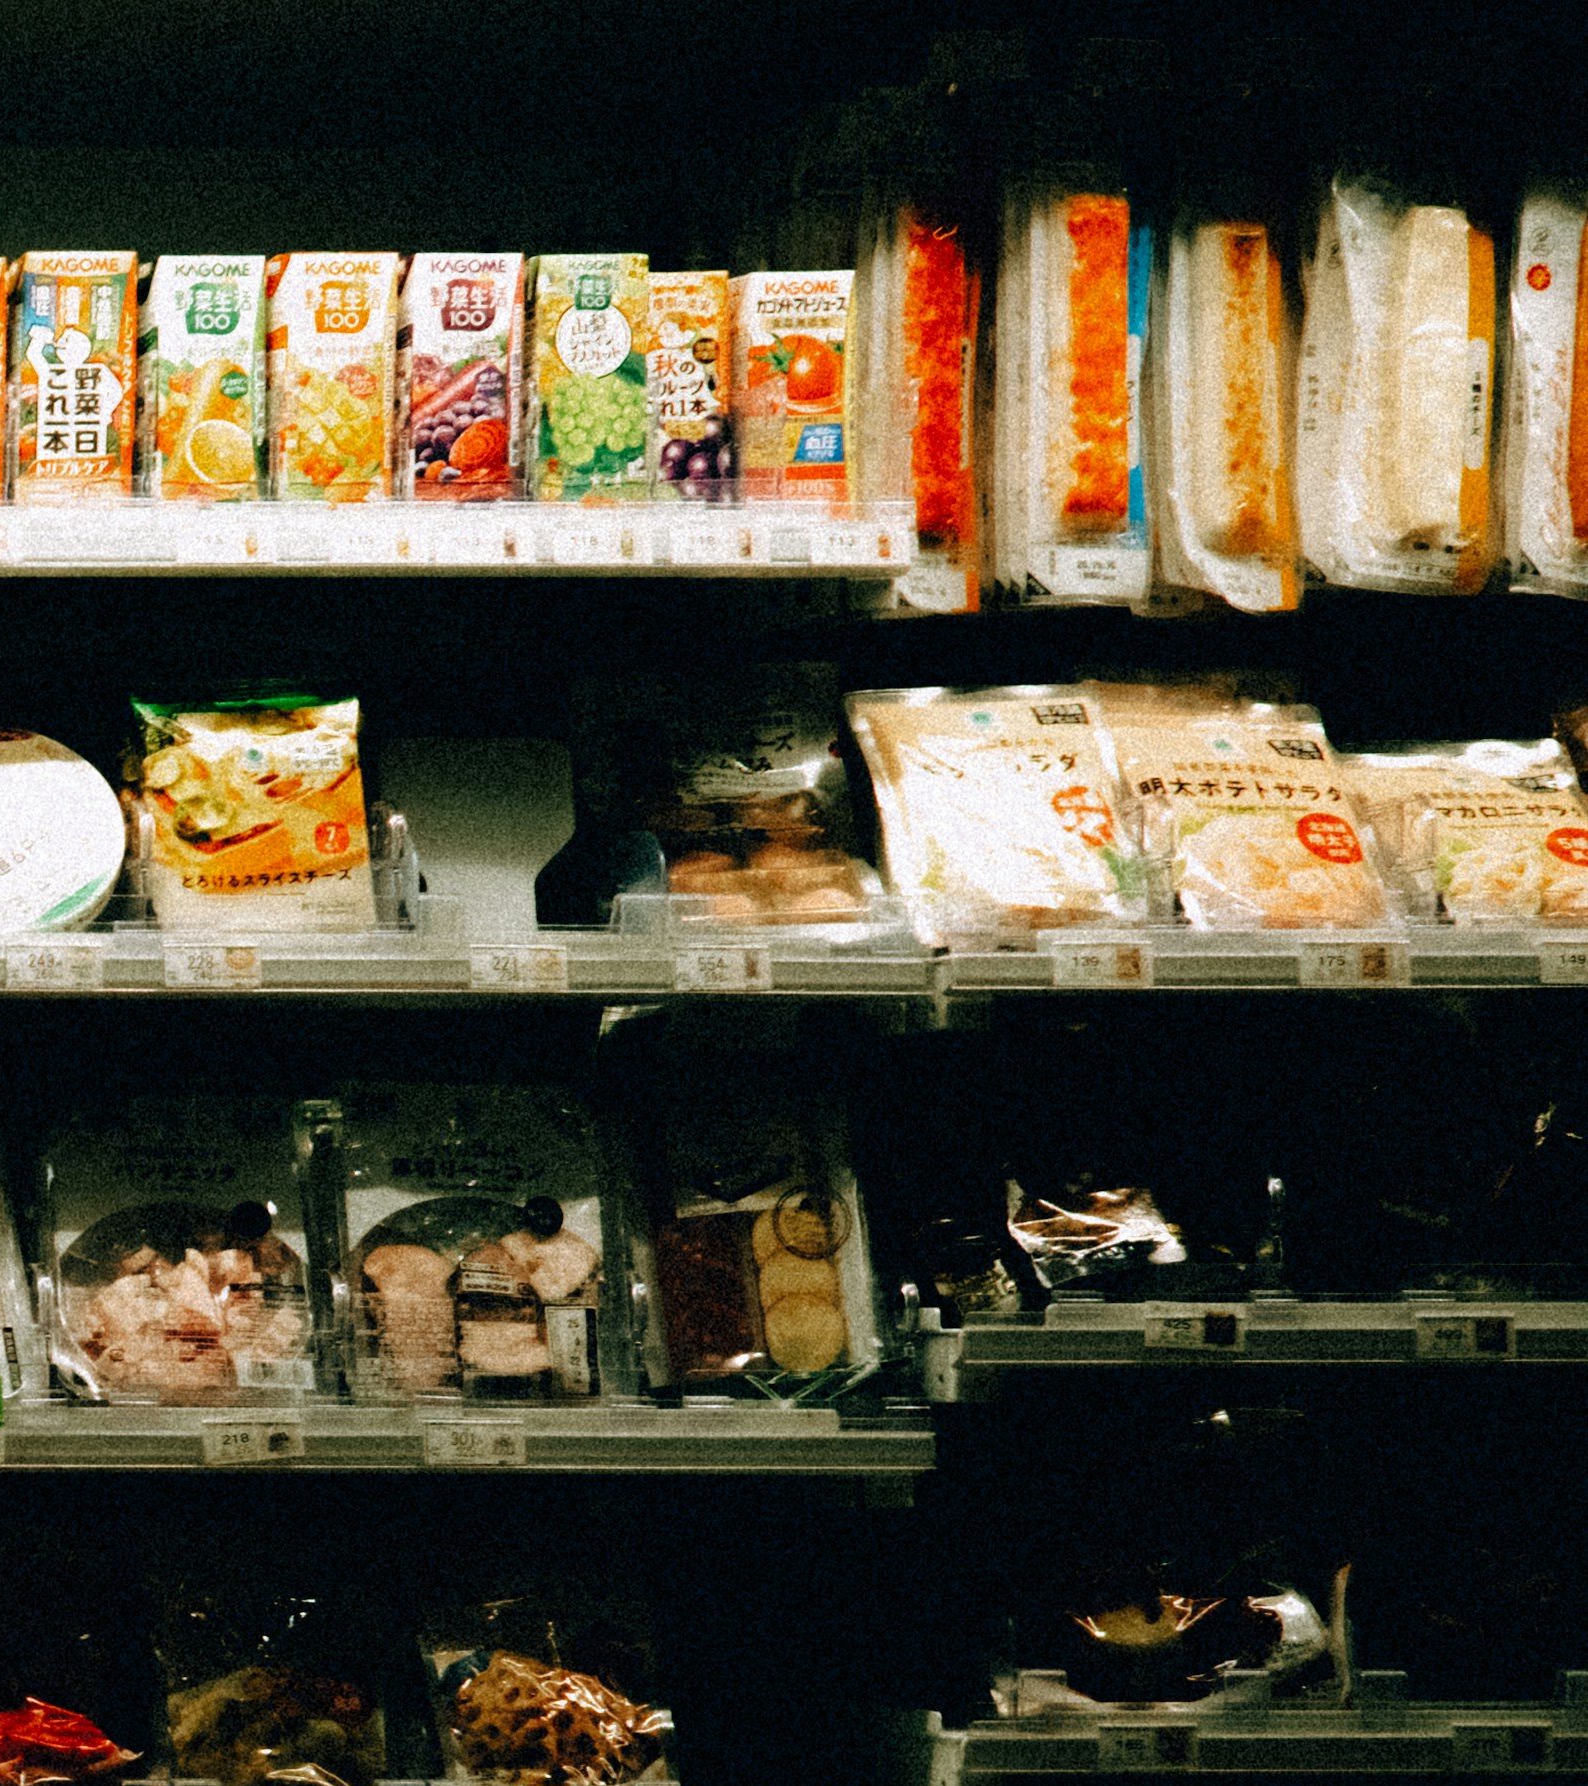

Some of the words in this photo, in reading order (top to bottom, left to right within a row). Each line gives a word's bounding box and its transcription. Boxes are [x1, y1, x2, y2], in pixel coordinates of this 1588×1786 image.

[41, 258, 119, 273] KAGOME
[175, 262, 250, 278] KAGOME
[304, 260, 381, 276] KAGOME
[430, 258, 507, 274] KAGOME
[764, 279, 839, 295] KAGOME
[194, 314, 231, 331] 100
[323, 313, 360, 329] 100
[449, 310, 487, 328] 100
[43, 368, 70, 453] これ一本
[74, 368, 100, 453] 野菜一日
[181, 868, 353, 889] とろけるスライスチーズ
